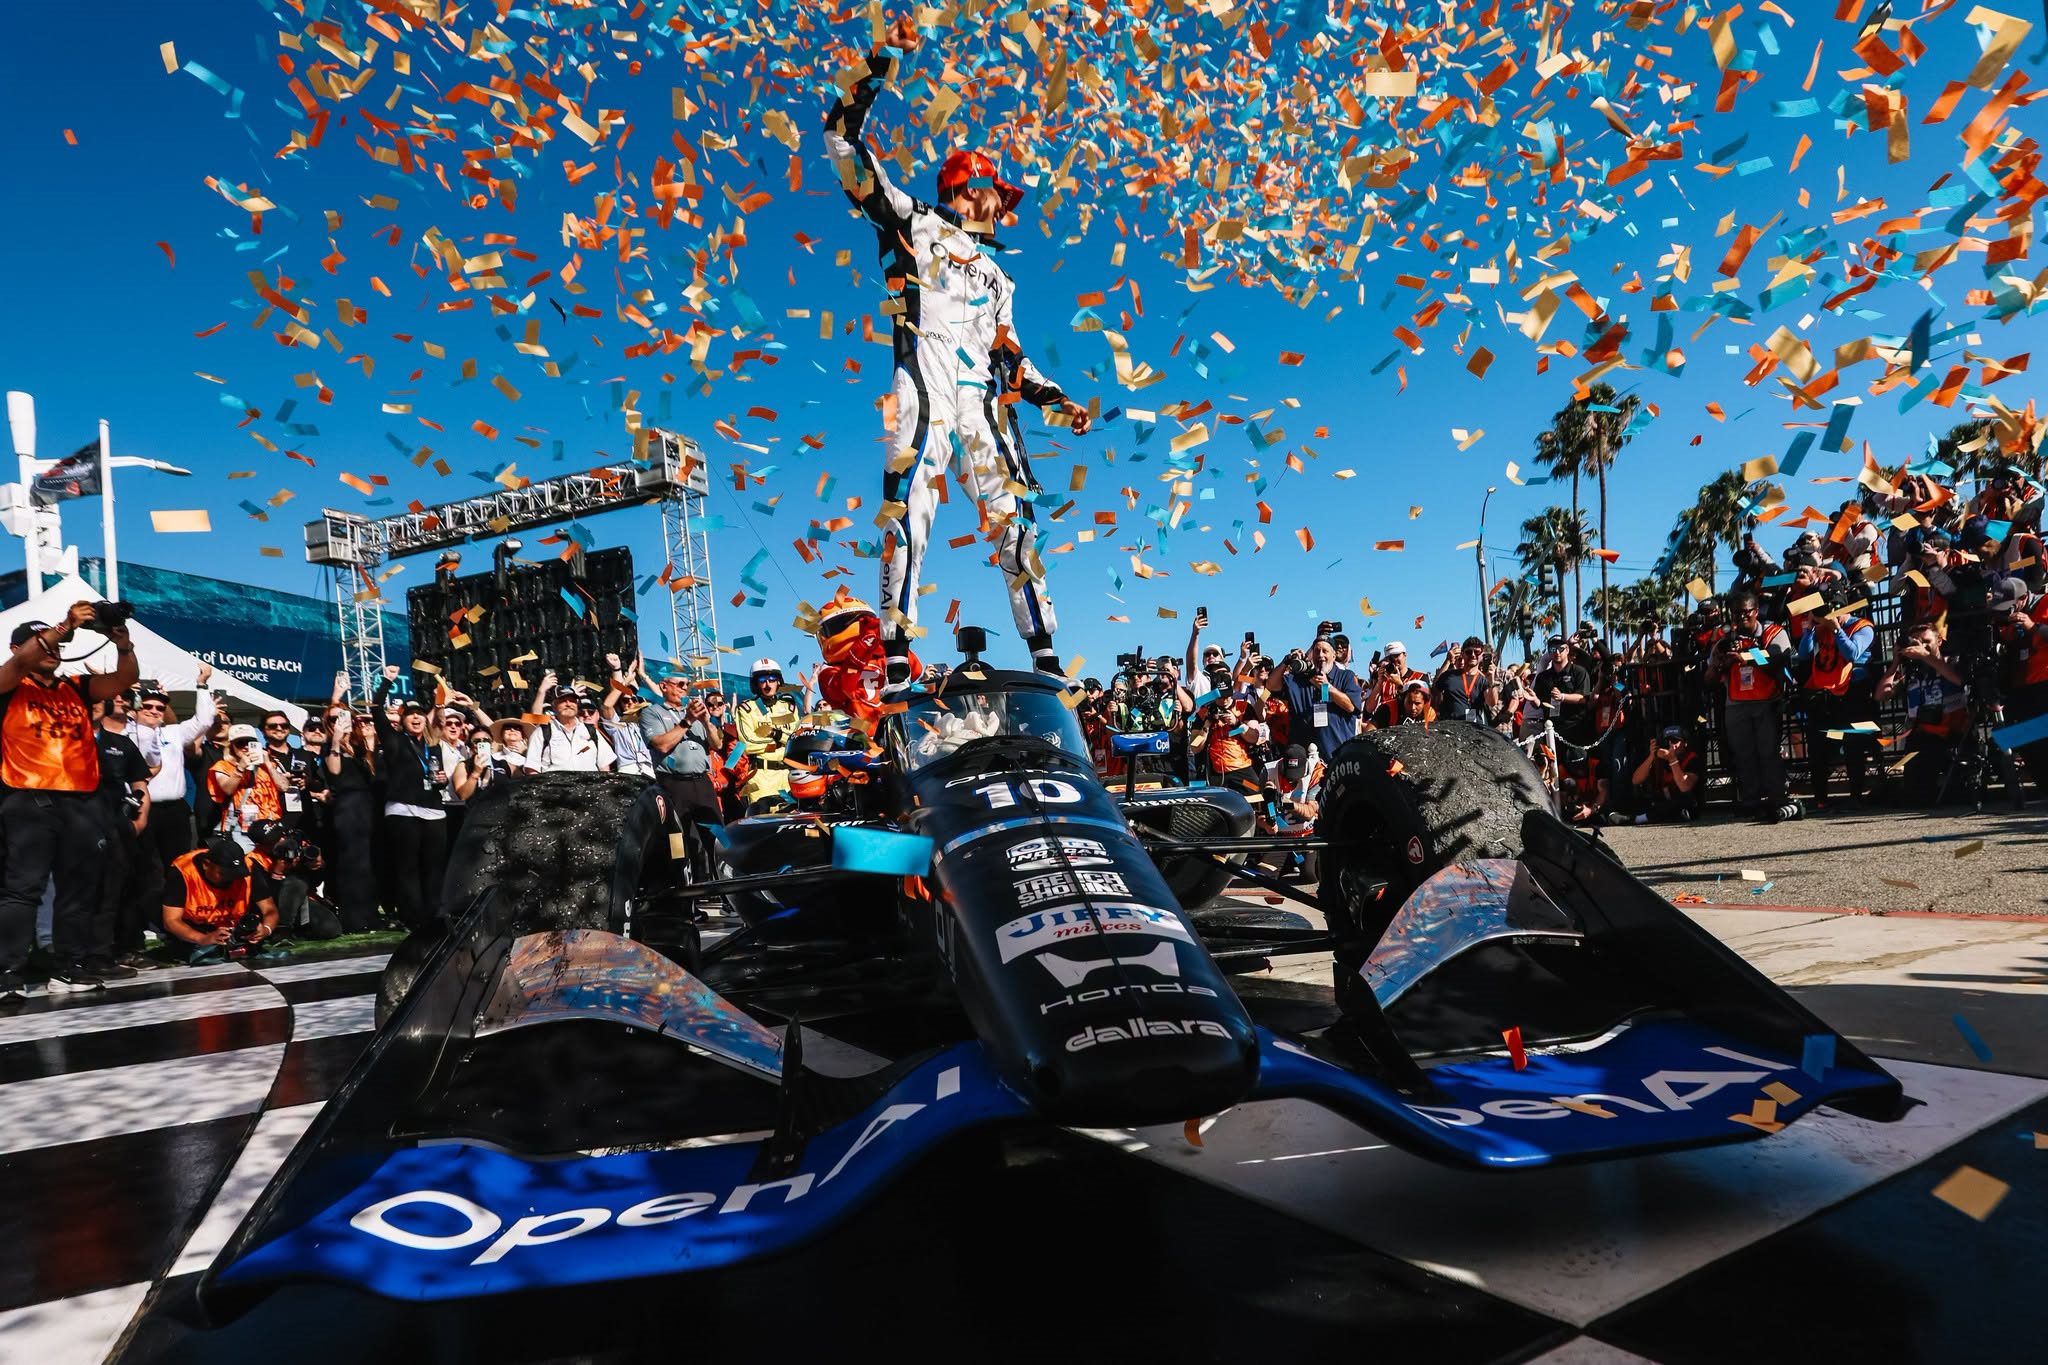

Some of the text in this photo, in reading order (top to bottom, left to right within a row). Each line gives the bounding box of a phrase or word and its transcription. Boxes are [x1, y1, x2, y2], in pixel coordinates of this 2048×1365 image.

[203, 650, 217, 665] of
[219, 652, 258, 669] LONG
[260, 657, 303, 673] BEACH
[235, 670, 270, 683] CHOICE
[975, 779, 1082, 809] 10
[1012, 872, 1126, 894] TRENCH
[1053, 921, 1142, 939] mixes
[1040, 982, 1218, 1015] Honda
[1064, 1017, 1232, 1052] dallara
[350, 1066, 961, 1265] OpenAI
